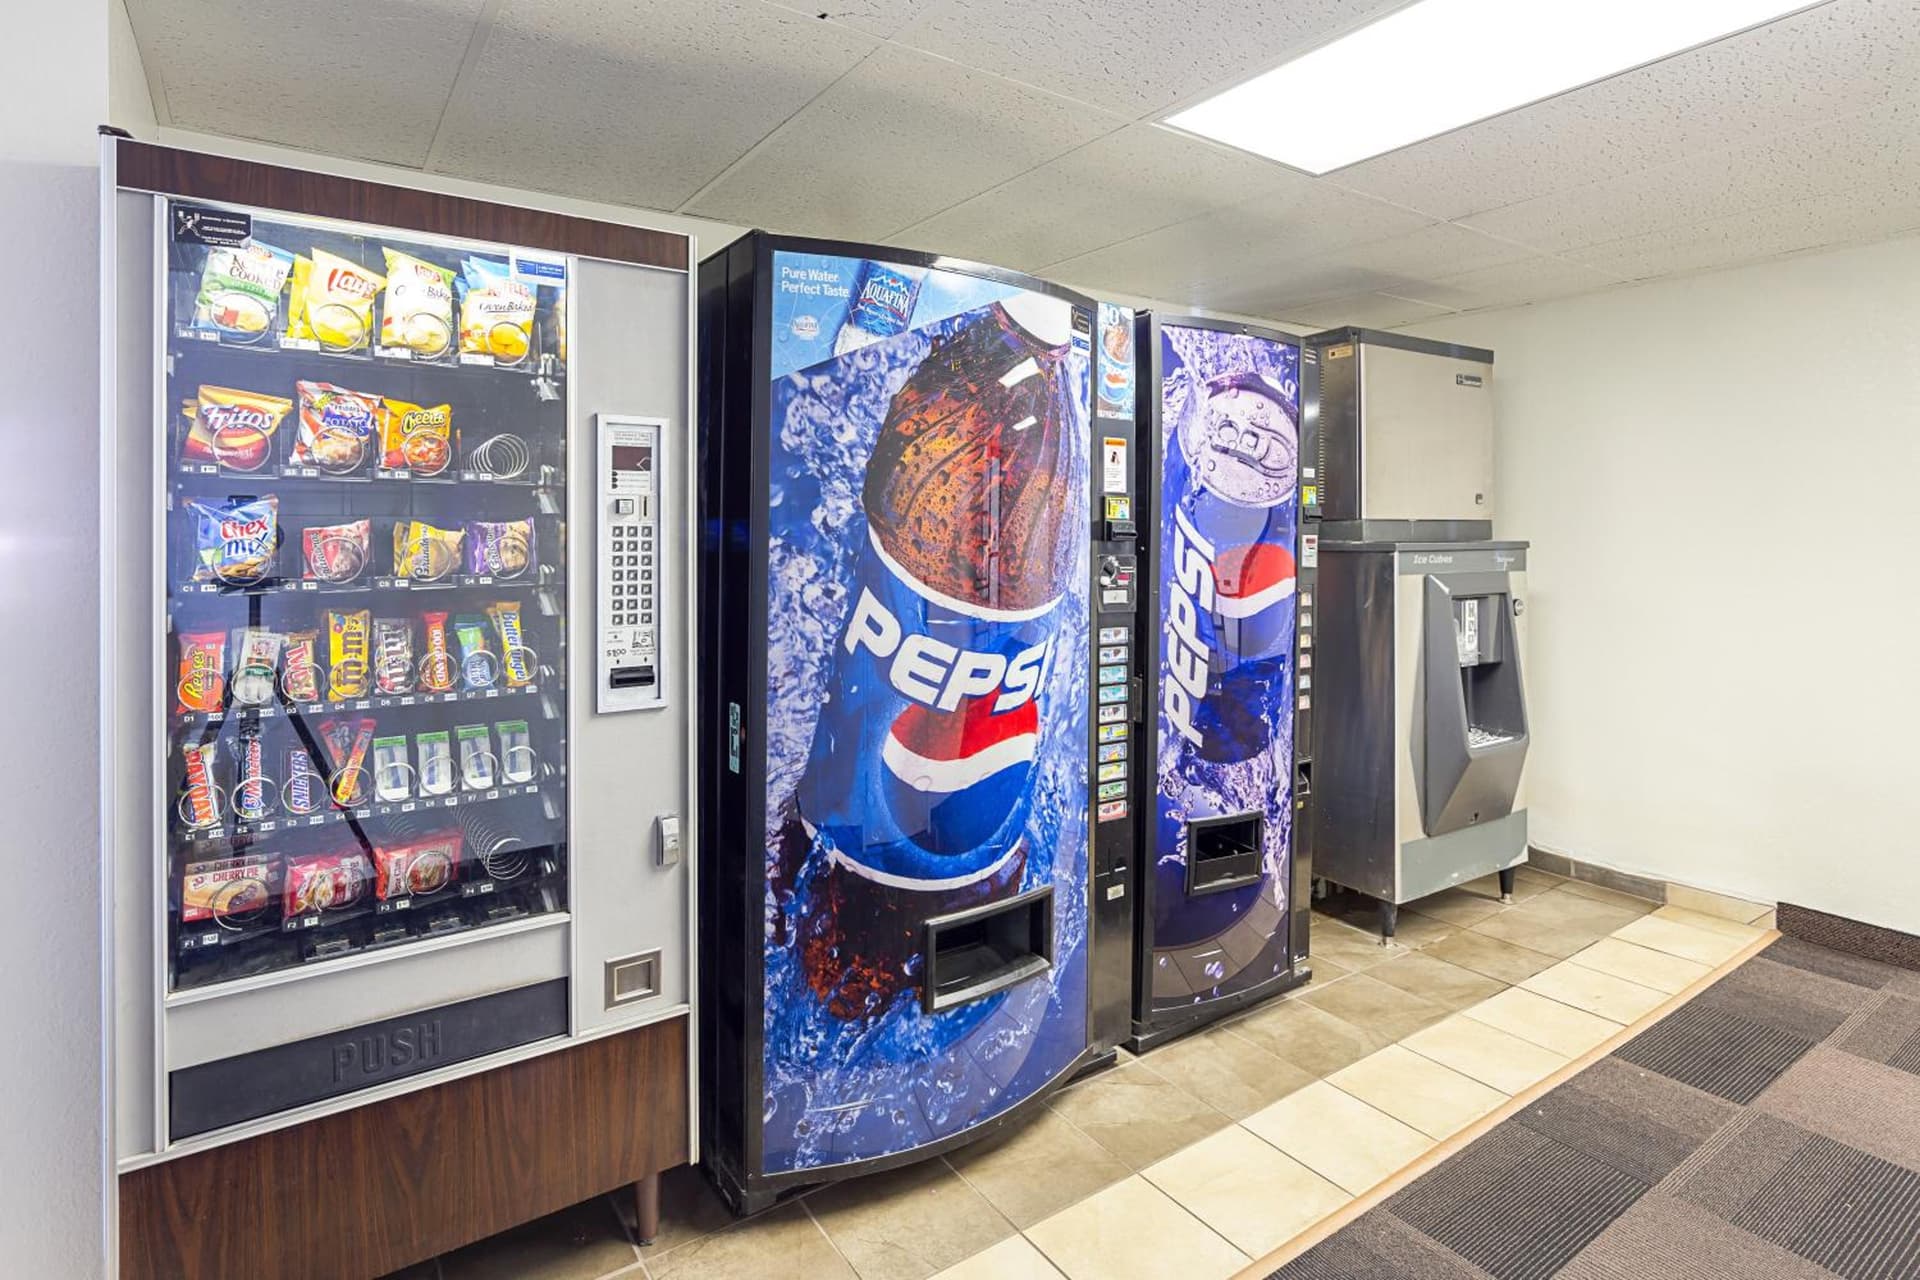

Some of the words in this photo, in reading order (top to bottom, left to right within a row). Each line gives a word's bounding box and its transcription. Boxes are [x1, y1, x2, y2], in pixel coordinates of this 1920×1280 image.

[782, 267, 807, 280] Pure
[807, 270, 838, 282] Water
[781, 281, 821, 295] Perfect
[860, 280, 909, 317] AQUAFINA
[201, 405, 274, 431] Fritos
[220, 516, 269, 540] Chex
[1413, 555, 1427, 565] Ice
[1428, 554, 1453, 564] Cubes
[1164, 503, 1216, 749] PEPSI
[844, 585, 1055, 713] PEPSI
[183, 649, 206, 699] Reese's
[183, 715, 195, 723] D1
[292, 751, 310, 810] SNICKERS
[213, 868, 245, 882] CHERRY
[247, 866, 258, 877] PIE
[331, 1020, 442, 1083] PUSH
